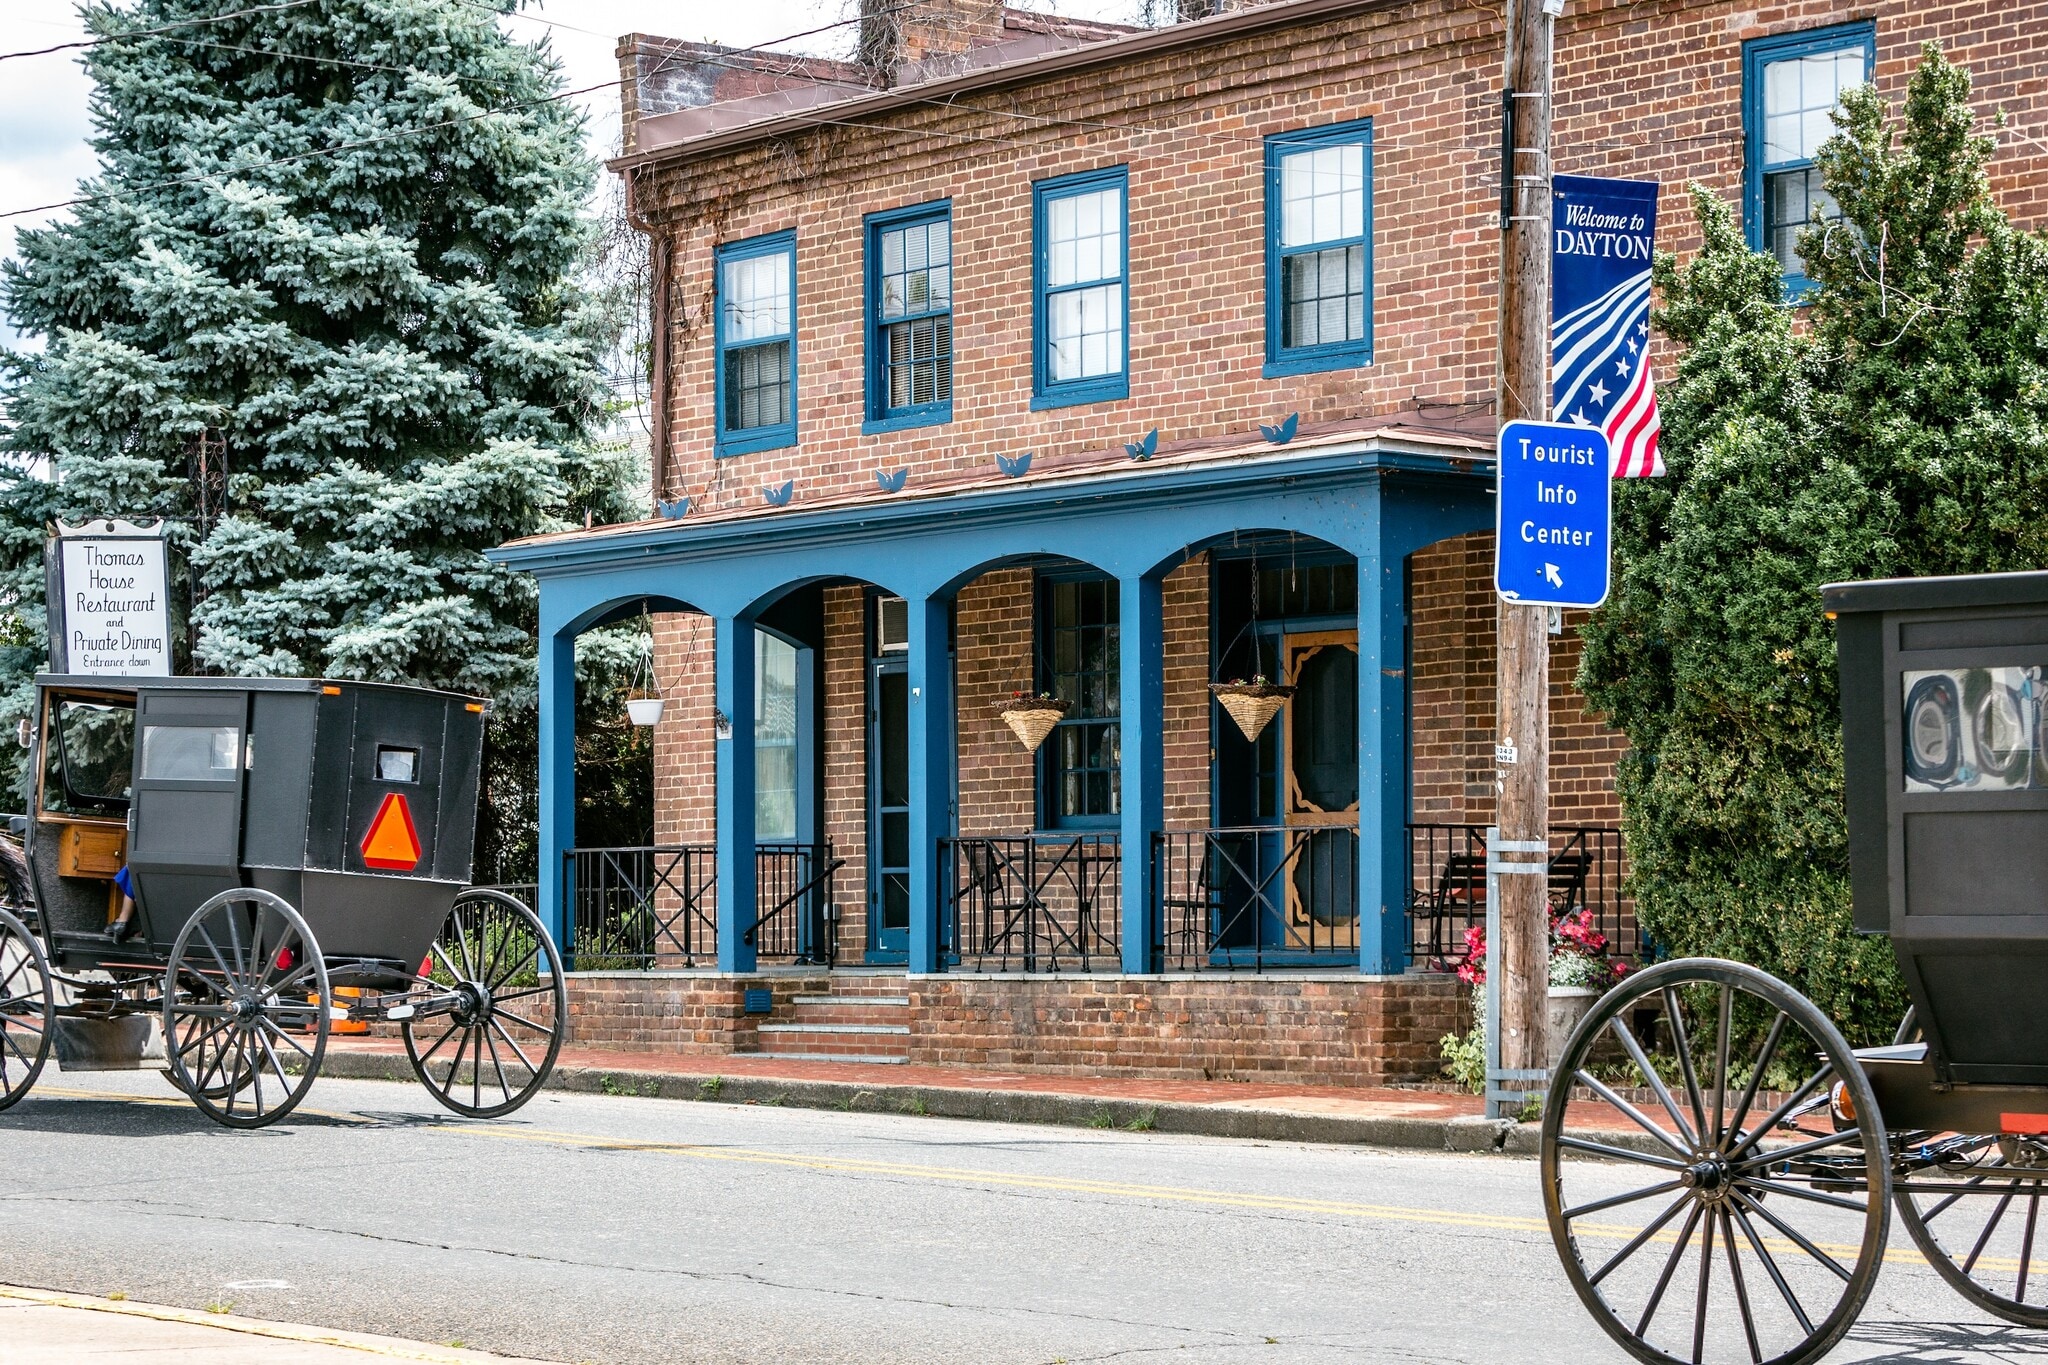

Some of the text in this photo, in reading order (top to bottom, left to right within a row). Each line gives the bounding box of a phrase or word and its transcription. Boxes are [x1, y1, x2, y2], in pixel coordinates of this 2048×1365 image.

[1566, 204, 1645, 231] Welcome to
[1555, 229, 1652, 260] DAYTON
[1518, 438, 1595, 465] Tourist
[1537, 481, 1577, 505] Info
[1520, 520, 1593, 546] Center
[83, 545, 145, 566] Thomas
[89, 569, 135, 589] House
[76, 592, 155, 613] Restaurant
[106, 616, 124, 627] and
[74, 630, 162, 653] Private Dining
[83, 654, 151, 667] Entrance down
